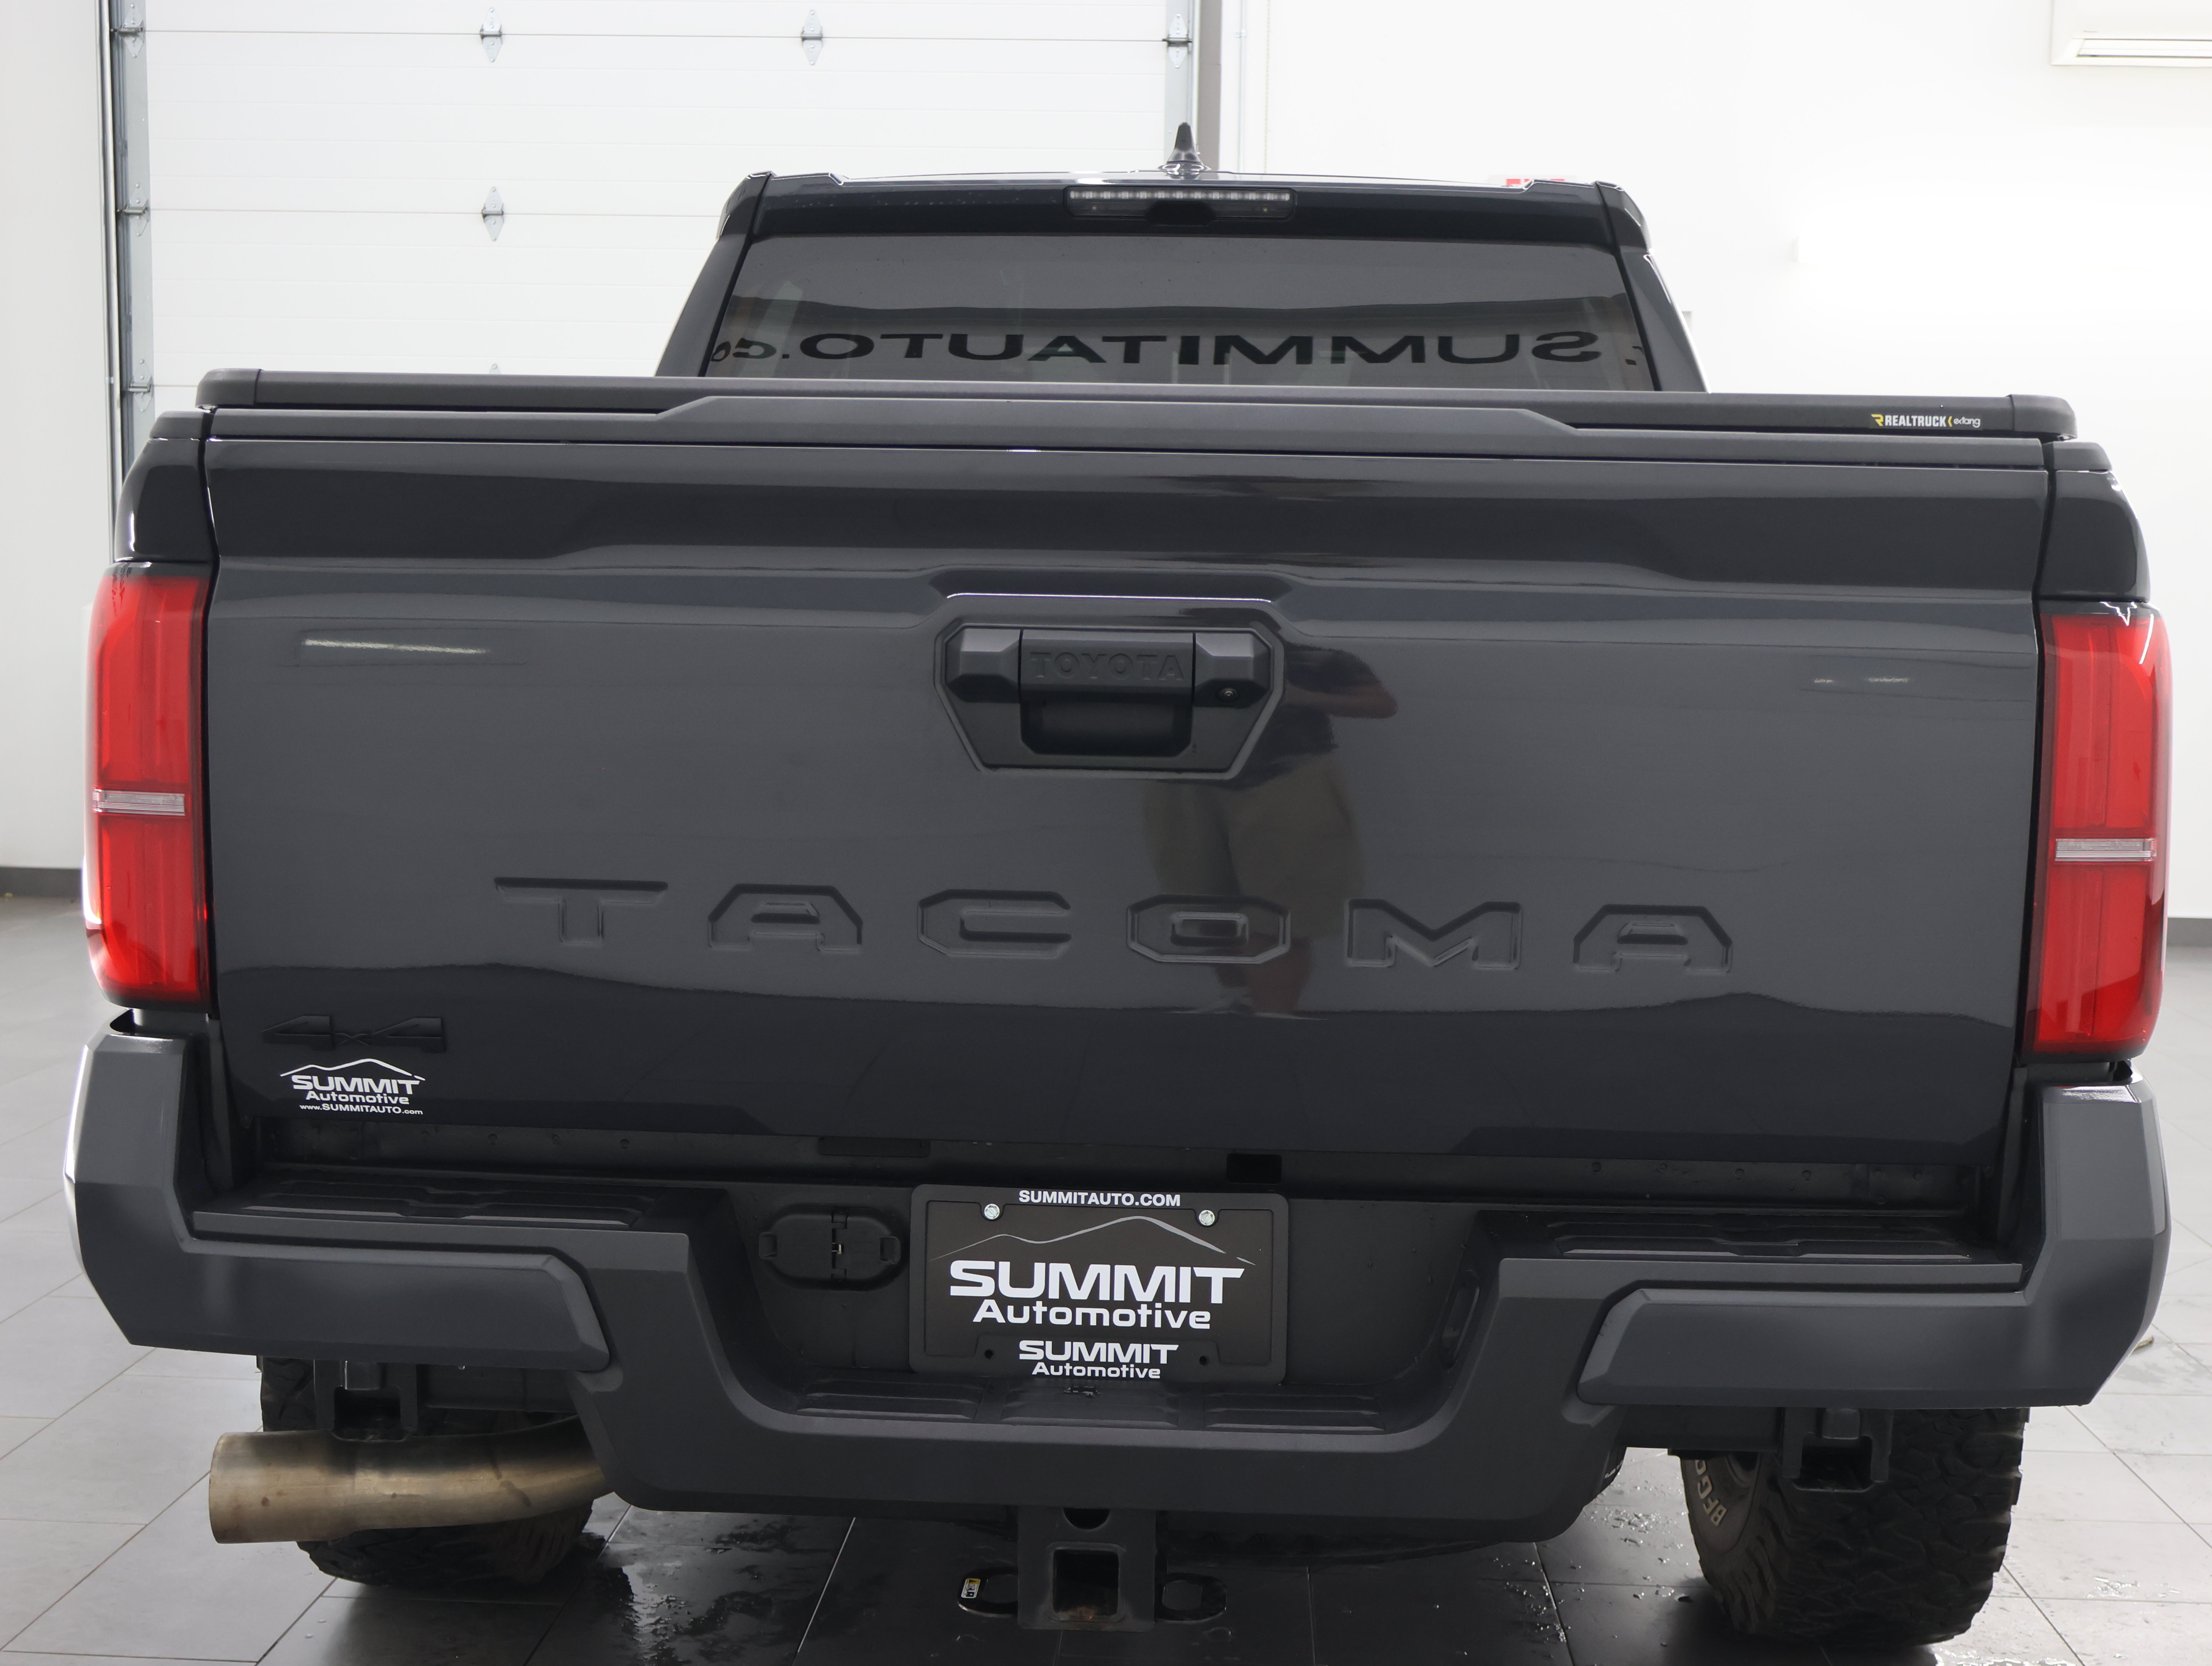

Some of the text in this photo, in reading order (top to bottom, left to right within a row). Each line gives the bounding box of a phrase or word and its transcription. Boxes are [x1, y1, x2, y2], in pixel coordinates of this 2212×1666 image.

[1885, 415, 1981, 428] REALTRUCK extang
[1030, 652, 1184, 681] TOYOTA
[493, 877, 1734, 975] TACOMA
[291, 1074, 420, 1095] SUMMIT
[305, 1091, 410, 1105] Automotive
[299, 1103, 424, 1115] www.SUMMITAUTO.com
[1019, 1190, 1181, 1207] SUMMITAUTO.COM
[950, 1260, 1245, 1304] SUMMIT
[973, 1299, 1211, 1329] Automotive
[1019, 1340, 1179, 1364] SUMMIT
[1032, 1362, 1161, 1379] Automotive
